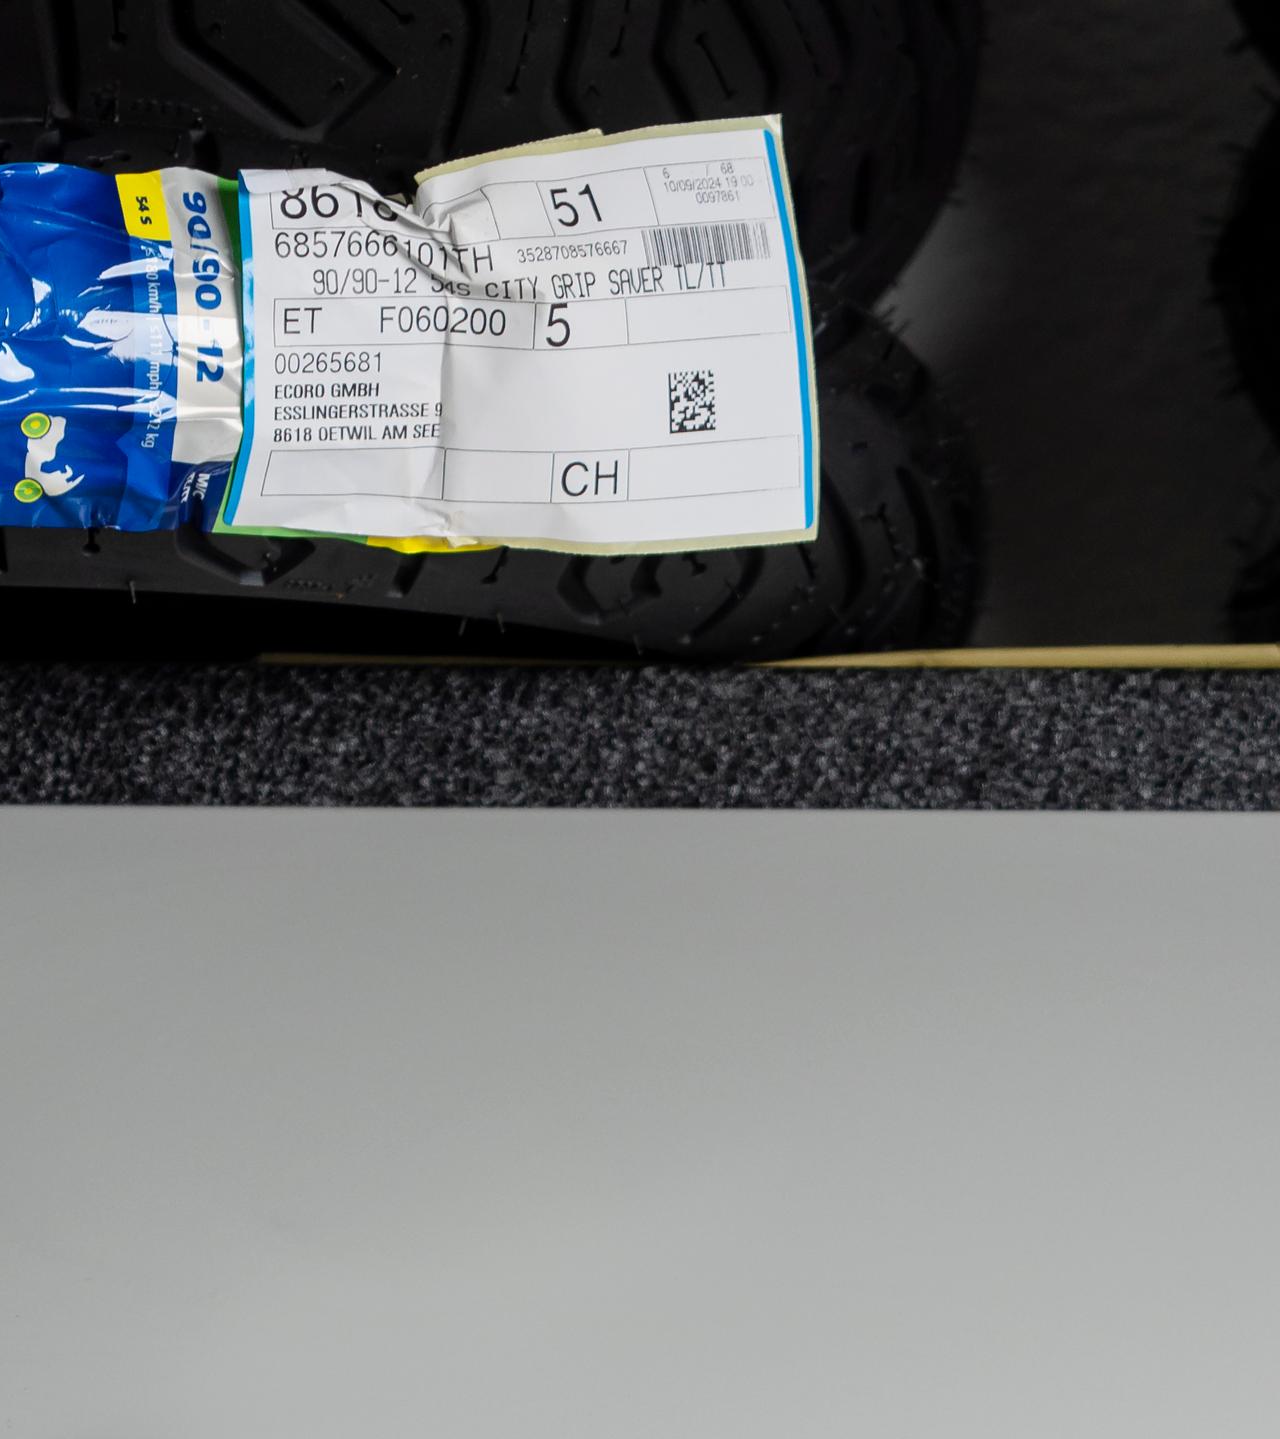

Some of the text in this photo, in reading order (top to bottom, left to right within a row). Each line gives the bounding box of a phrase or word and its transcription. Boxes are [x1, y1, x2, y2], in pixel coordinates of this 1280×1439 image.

[720, 162, 735, 175] 68
[135, 196, 152, 225] 54 S
[550, 184, 602, 227] 51
[516, 239, 628, 264] 3528708576667
[312, 267, 418, 295] 90/90-12
[484, 276, 539, 300] CITY
[551, 271, 597, 299] GRIP
[608, 266, 665, 296] SAVER
[673, 260, 727, 290] TL/TT
[147, 282, 163, 314] km/h
[283, 303, 571, 348] ET F060200 5
[146, 361, 163, 390] mph
[273, 351, 383, 375] 00265681
[273, 382, 380, 400] ECORO GMBH
[273, 402, 443, 421] ESSLINGERSTRASSE 9
[140, 433, 161, 449] kg
[273, 423, 441, 443] 8618 OETWIL AM SEE
[560, 459, 620, 497] CH
